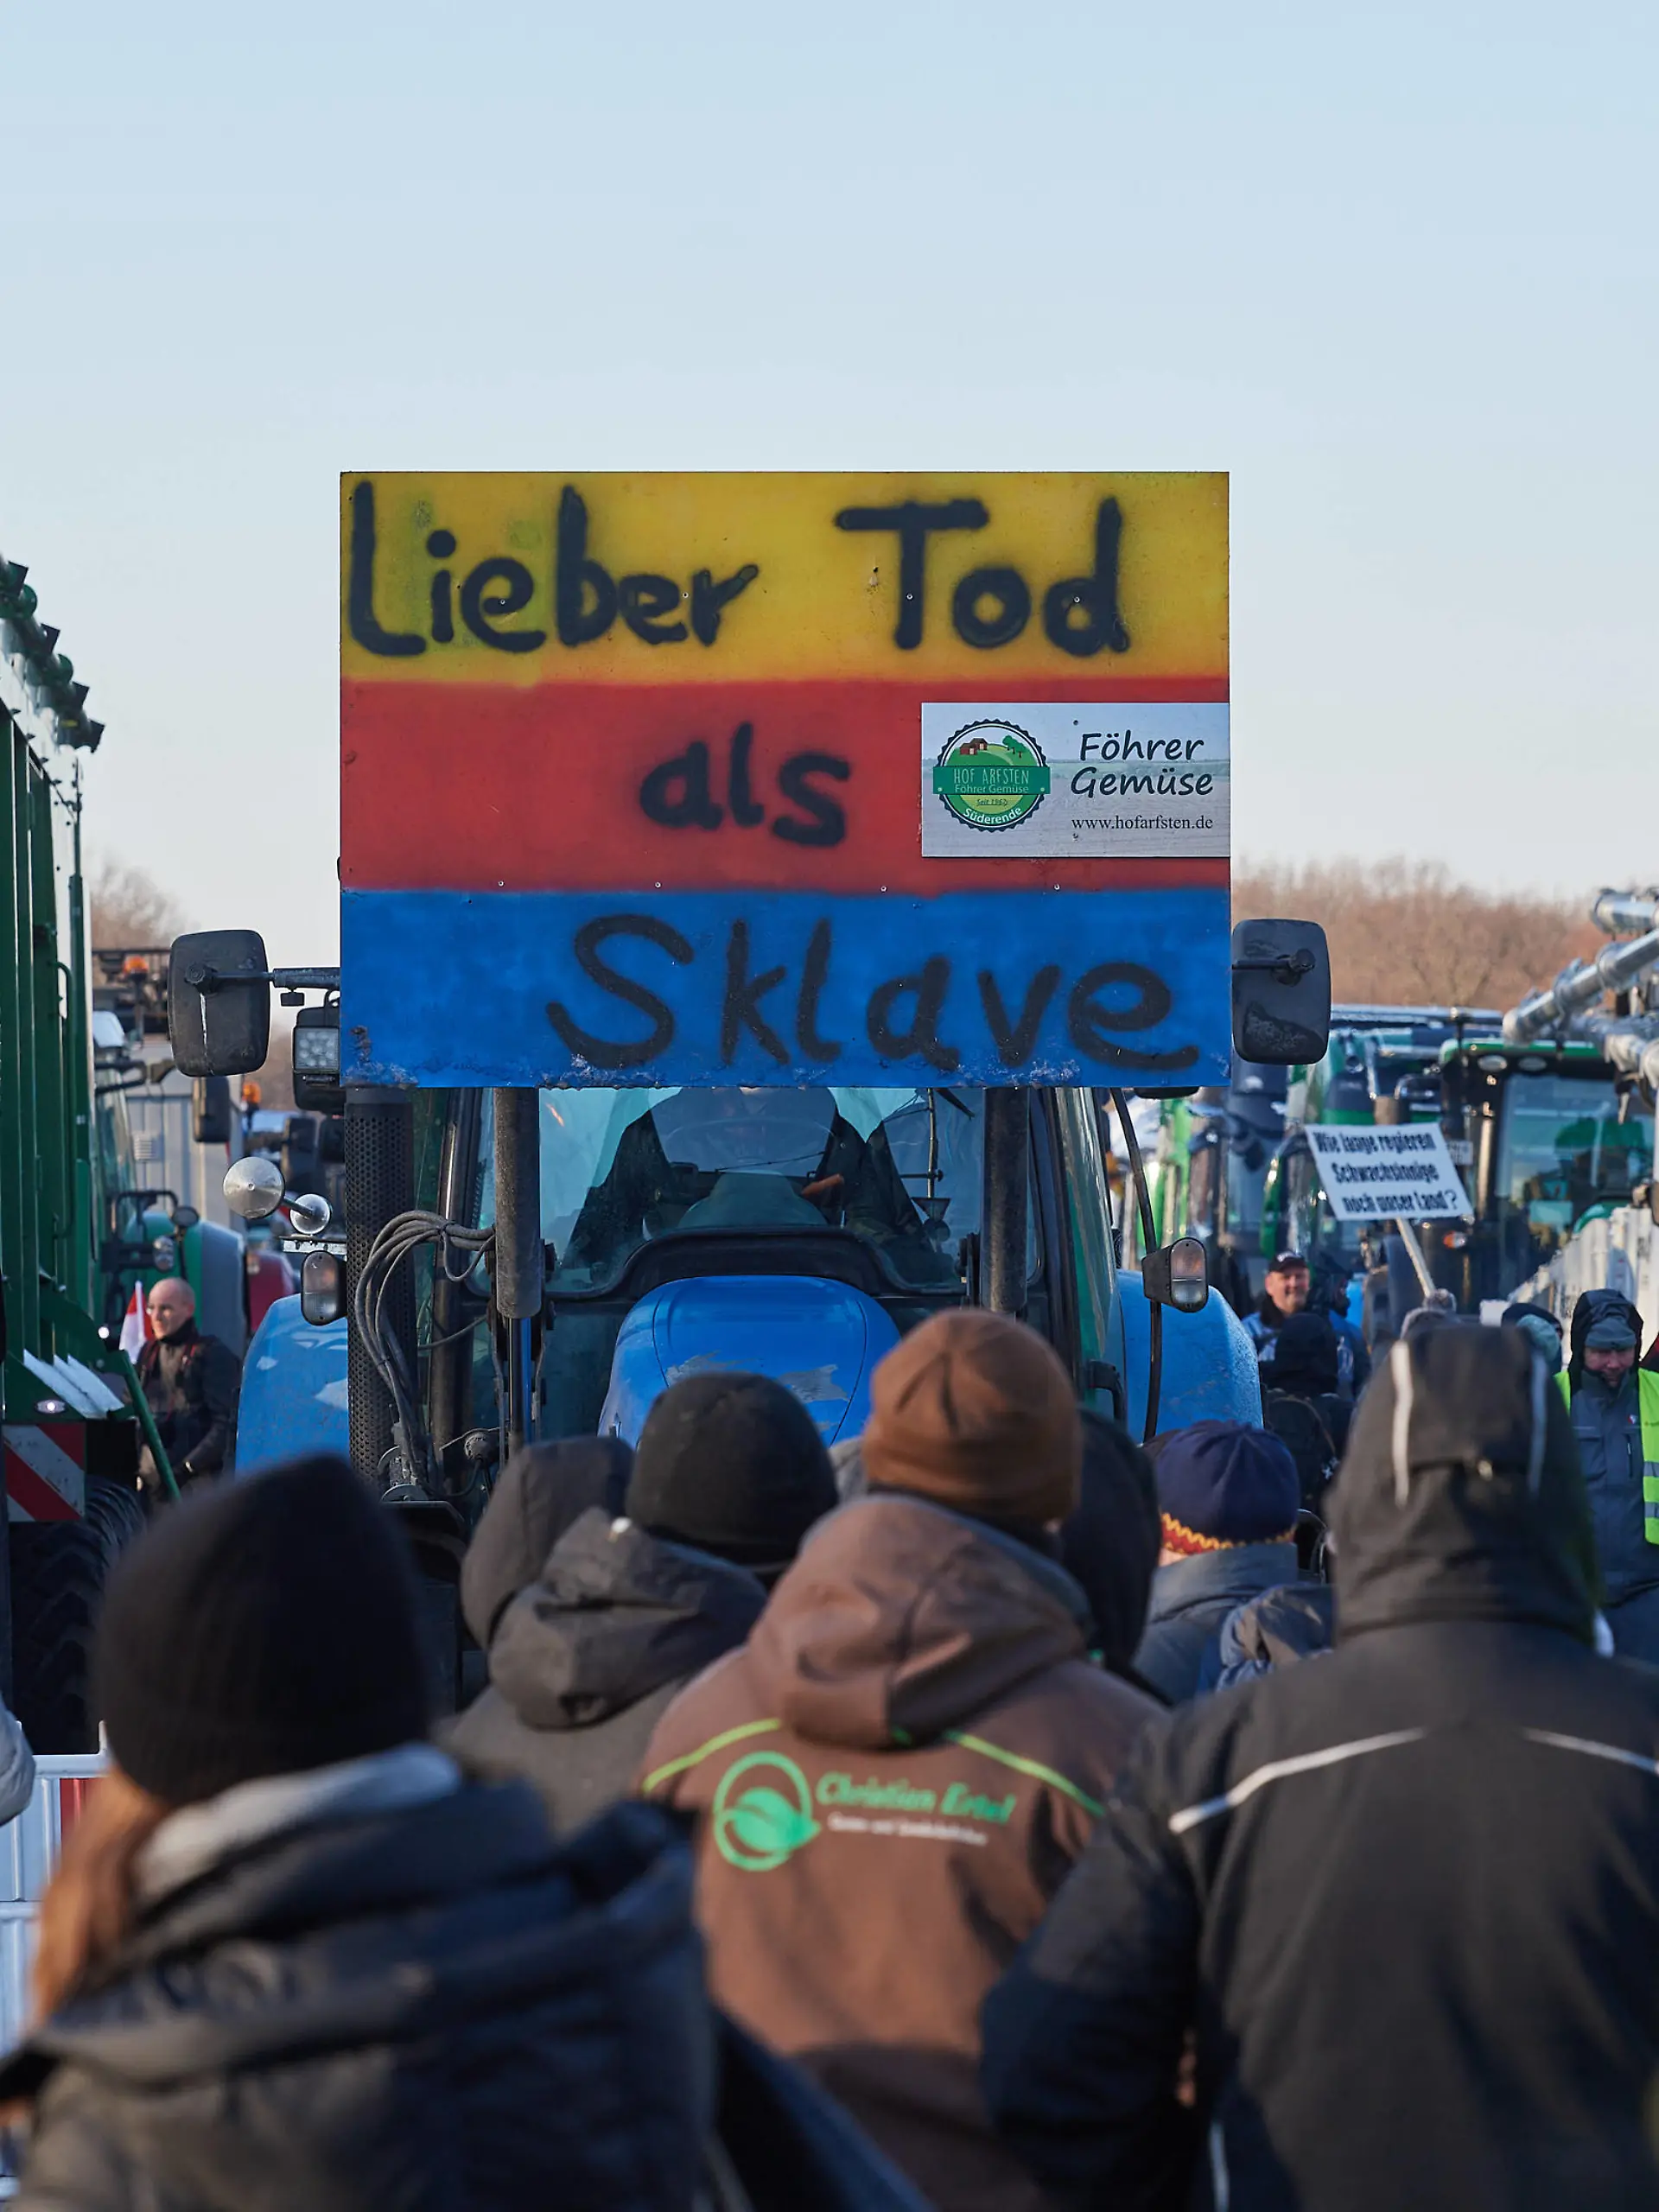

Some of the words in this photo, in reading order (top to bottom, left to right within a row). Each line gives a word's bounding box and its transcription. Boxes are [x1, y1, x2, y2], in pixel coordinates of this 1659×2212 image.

[347, 480, 760, 657] Lieber
[834, 497, 1130, 658] Tod
[1079, 729, 1205, 761] Föhrer
[639, 722, 852, 848] als
[953, 768, 976, 785] HOF
[982, 768, 1029, 785] ARFSTEN
[955, 784, 987, 794] Föhrer
[988, 784, 1029, 794] Gemüse
[1071, 766, 1214, 798] Gemüse
[963, 807, 1023, 824] Süderende
[1071, 815, 1214, 830] www.hofarfsten.de
[545, 914, 1199, 1071] Sklave
[1378, 1130, 1437, 1154] regieren
